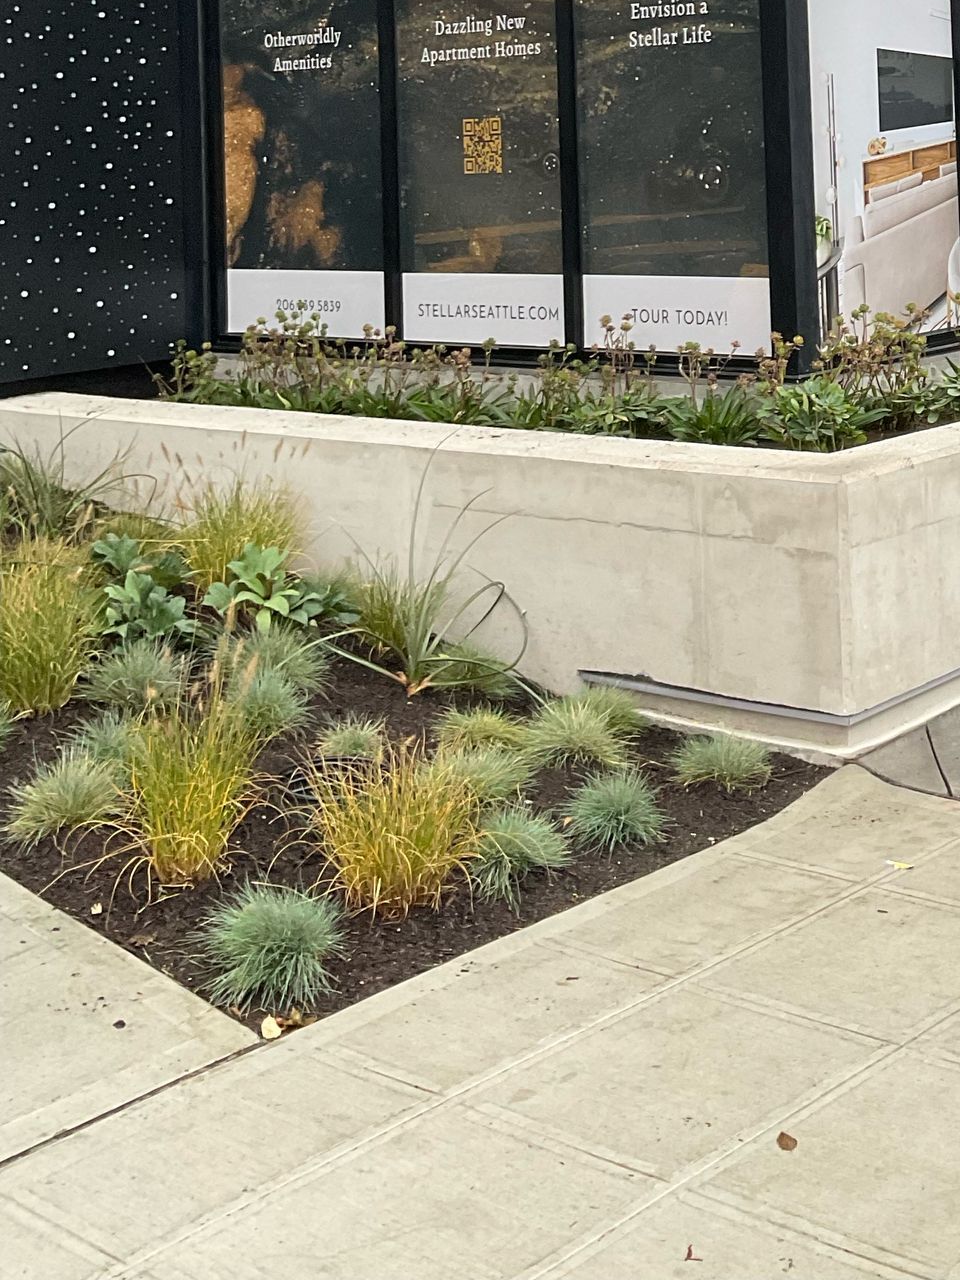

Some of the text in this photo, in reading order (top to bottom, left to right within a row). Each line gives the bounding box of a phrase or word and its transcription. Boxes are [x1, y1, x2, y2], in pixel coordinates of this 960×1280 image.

[630, 0, 708, 19] Envision a
[435, 14, 526, 36] Dazzling New
[264, 27, 341, 48] Otherworldly
[629, 24, 712, 48] Stellar Life
[273, 54, 332, 72] Amenities
[421, 41, 541, 67] Apartment Homes
[418, 303, 559, 321] STELLARSEATTLE.COM
[631, 308, 728, 326] TOUR TODAY!
